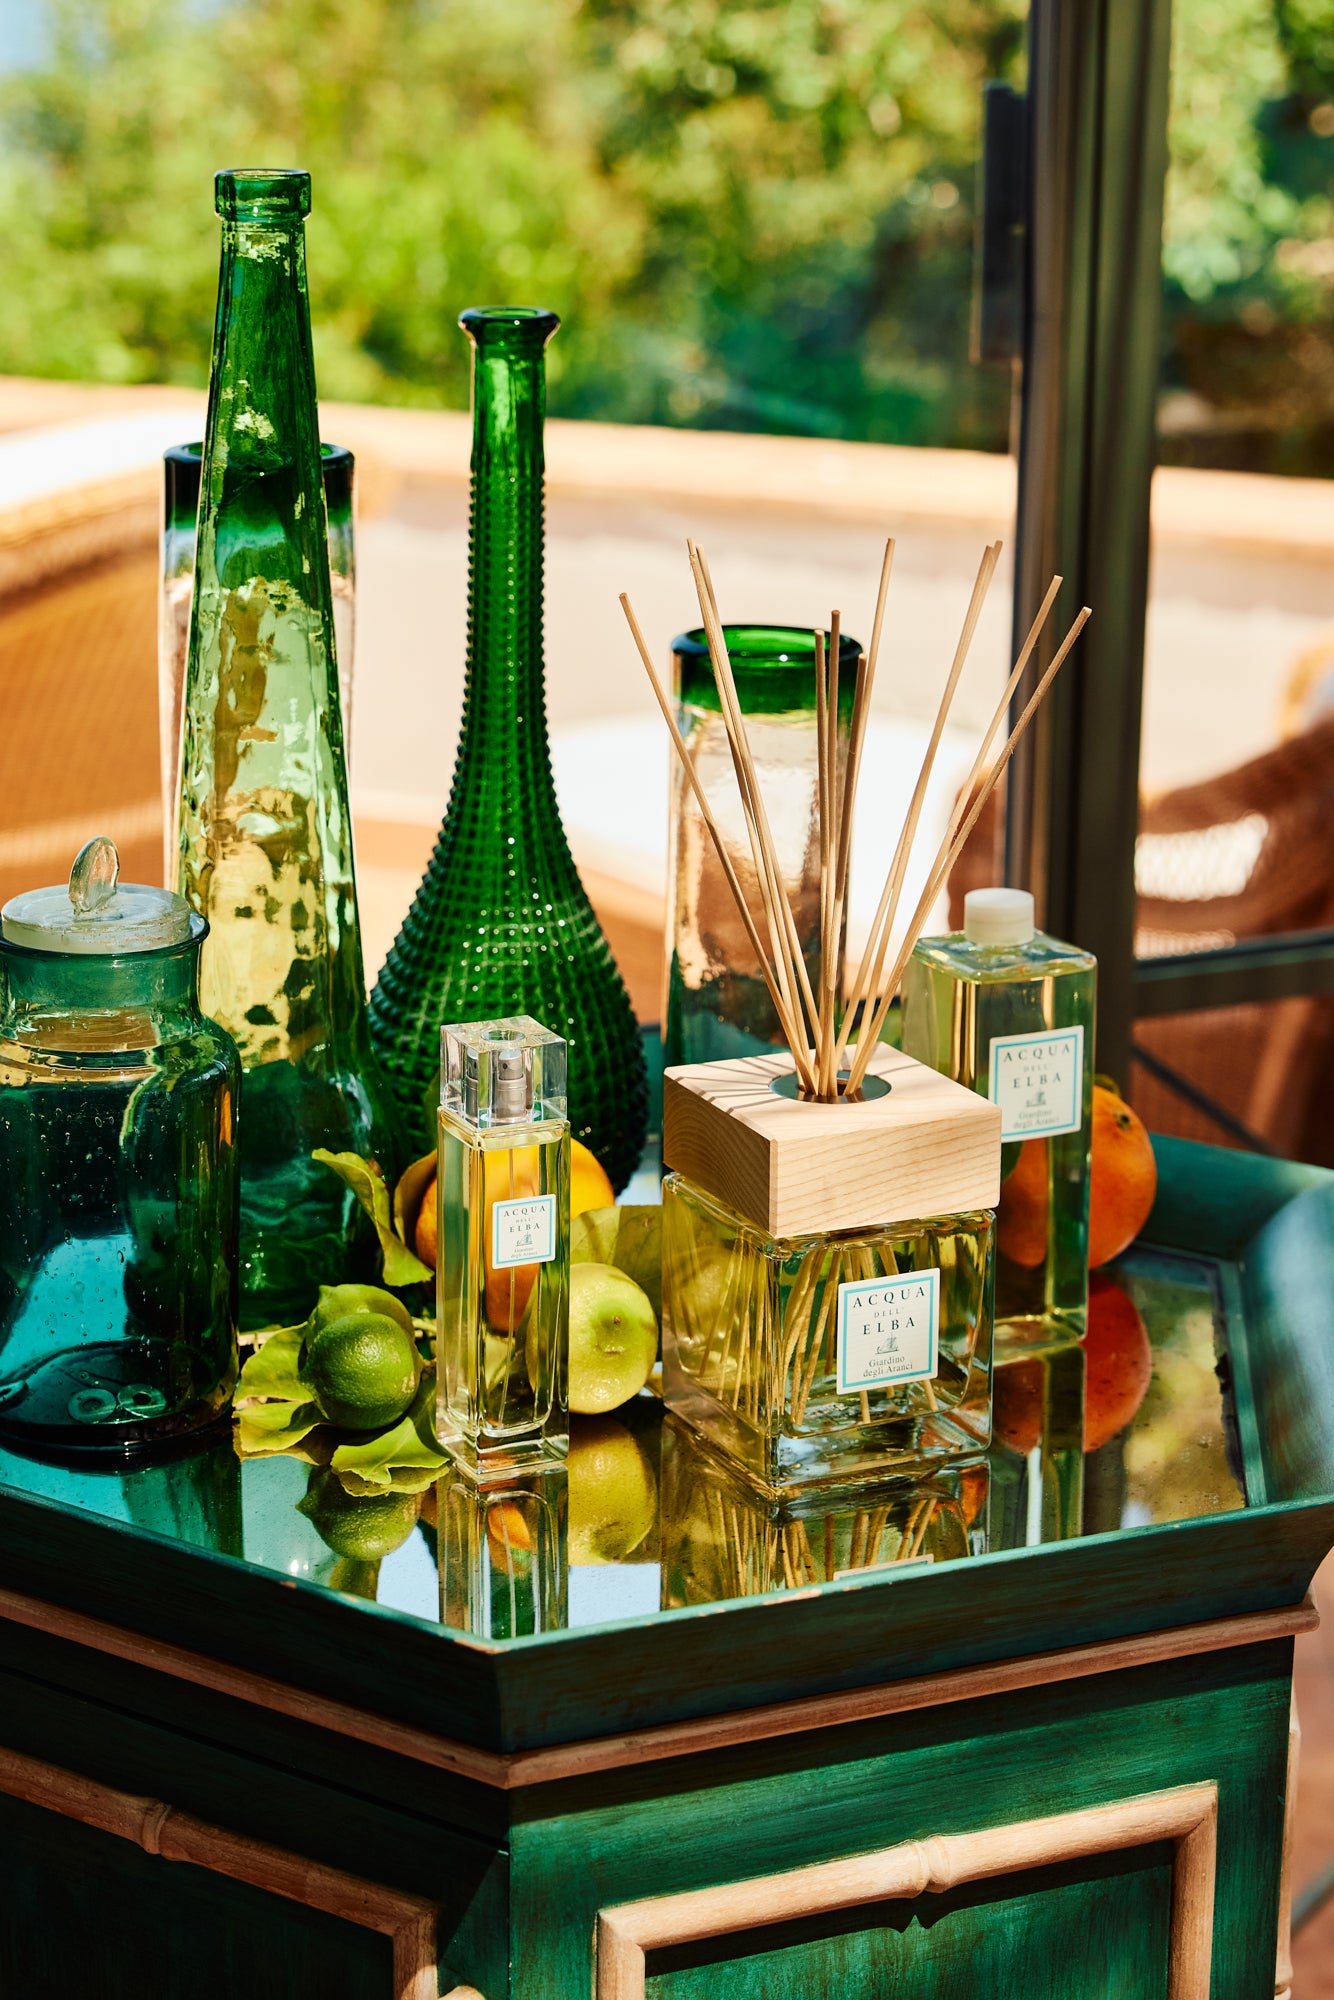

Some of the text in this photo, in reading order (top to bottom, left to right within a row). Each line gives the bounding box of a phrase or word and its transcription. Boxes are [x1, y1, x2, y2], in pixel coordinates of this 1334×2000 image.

[1003, 1044, 1070, 1062] ACQUA
[1013, 1073, 1061, 1088] ELBA
[503, 1205, 545, 1217] ACQUA
[509, 1223, 540, 1233] ELBA
[853, 1286, 925, 1308] ACQUA
[863, 1317, 915, 1335] ELBA
[868, 1356, 905, 1368] Giardino
[863, 1363, 913, 1378] degli Aranci
